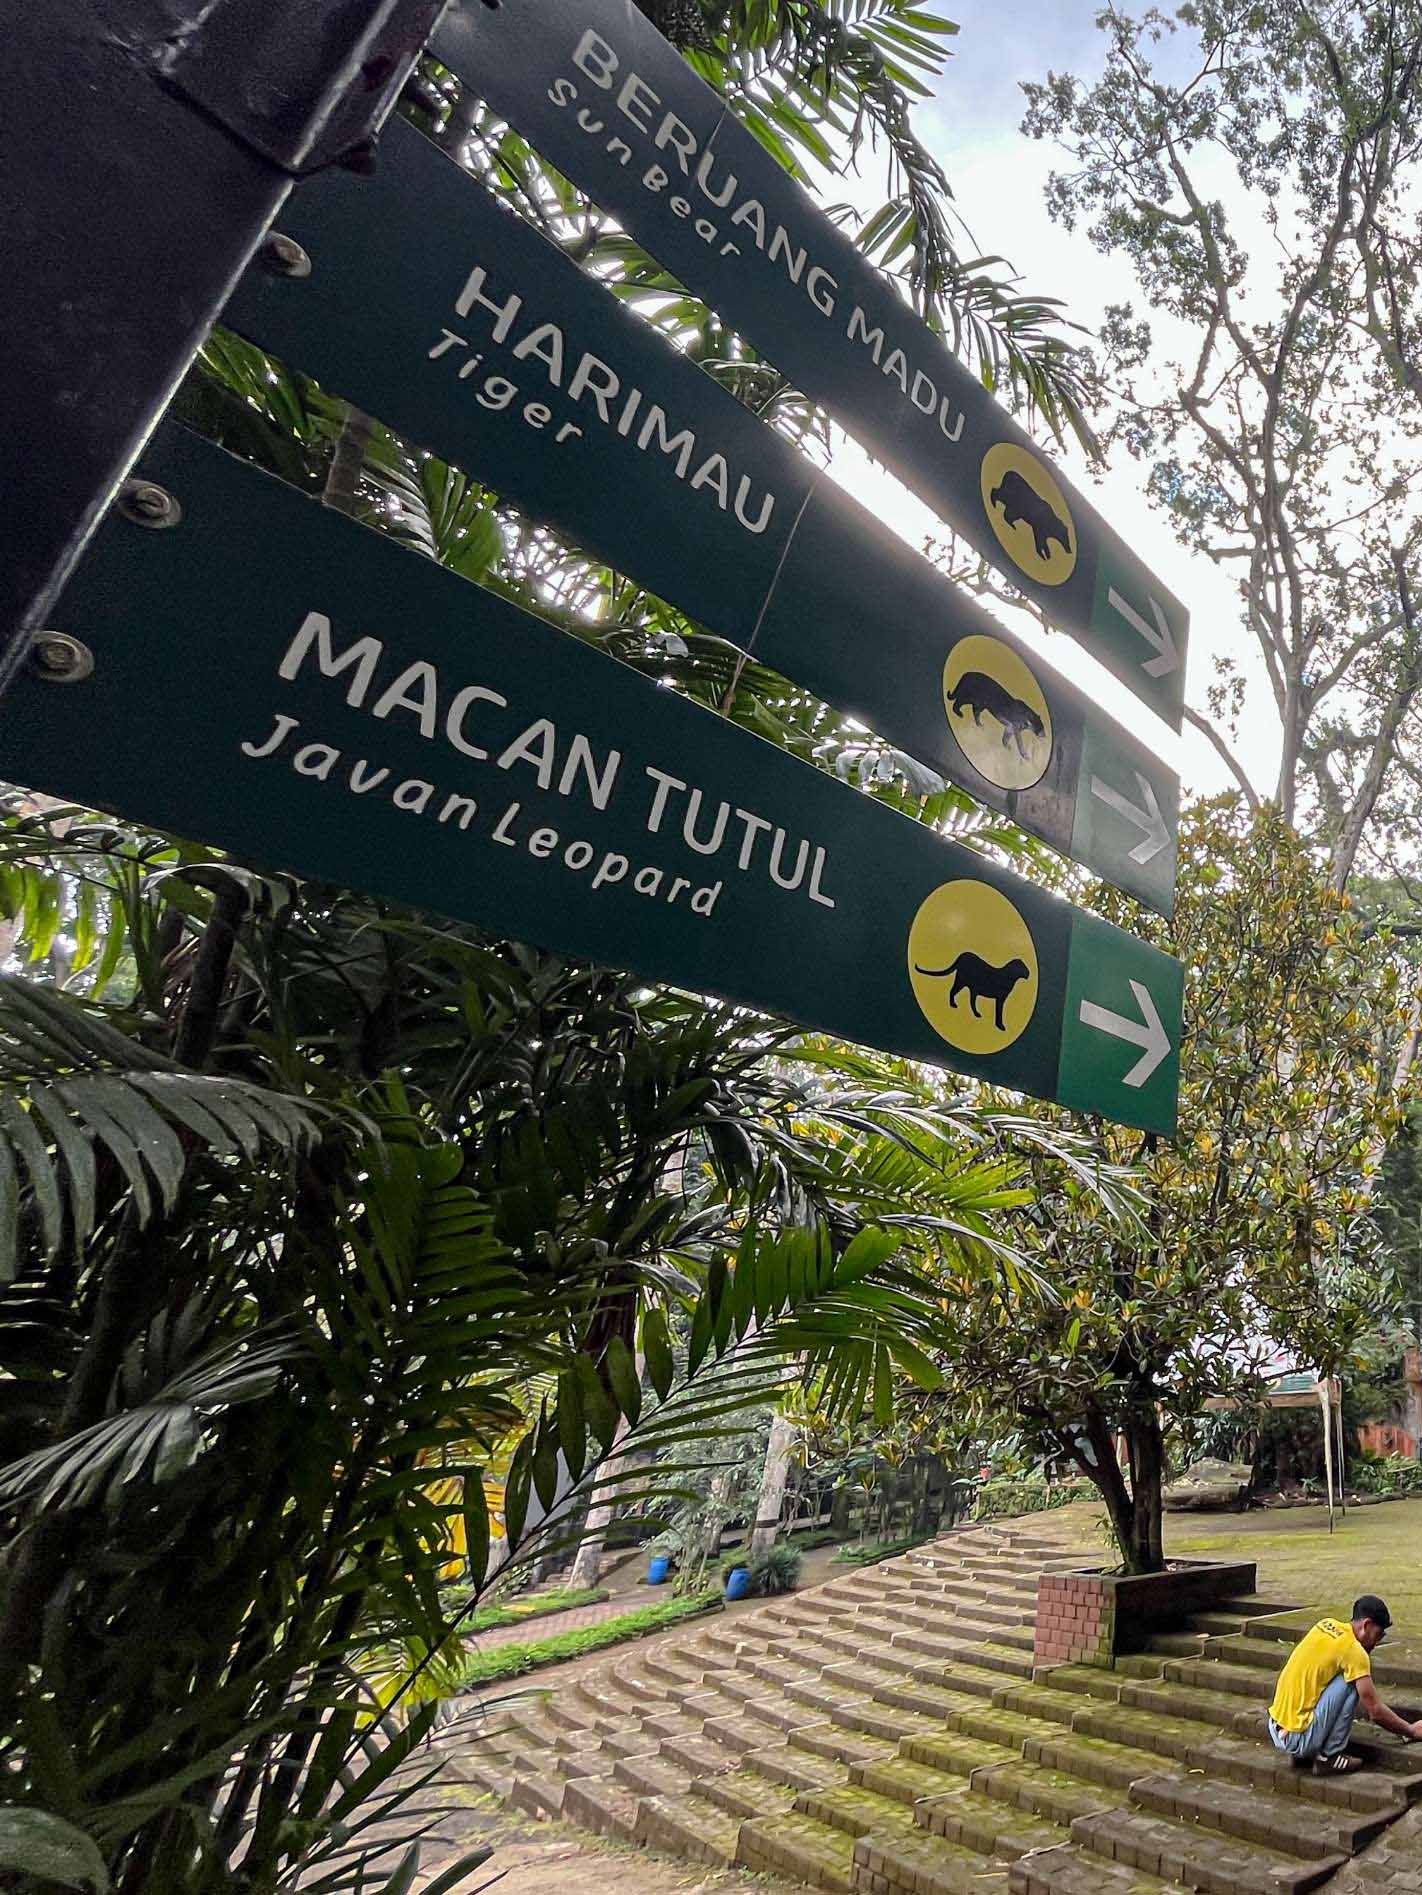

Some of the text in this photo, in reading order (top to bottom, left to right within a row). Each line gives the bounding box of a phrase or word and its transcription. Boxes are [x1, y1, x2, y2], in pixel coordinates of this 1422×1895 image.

[548, 78, 740, 257] Sun Bear
[572, 29, 966, 443] BERUANG MADU
[428, 329, 582, 443] Tiger
[455, 266, 775, 534] HARIMAU
[242, 714, 722, 917] Javan Leopard
[278, 611, 837, 907] MACAN TUTUL
